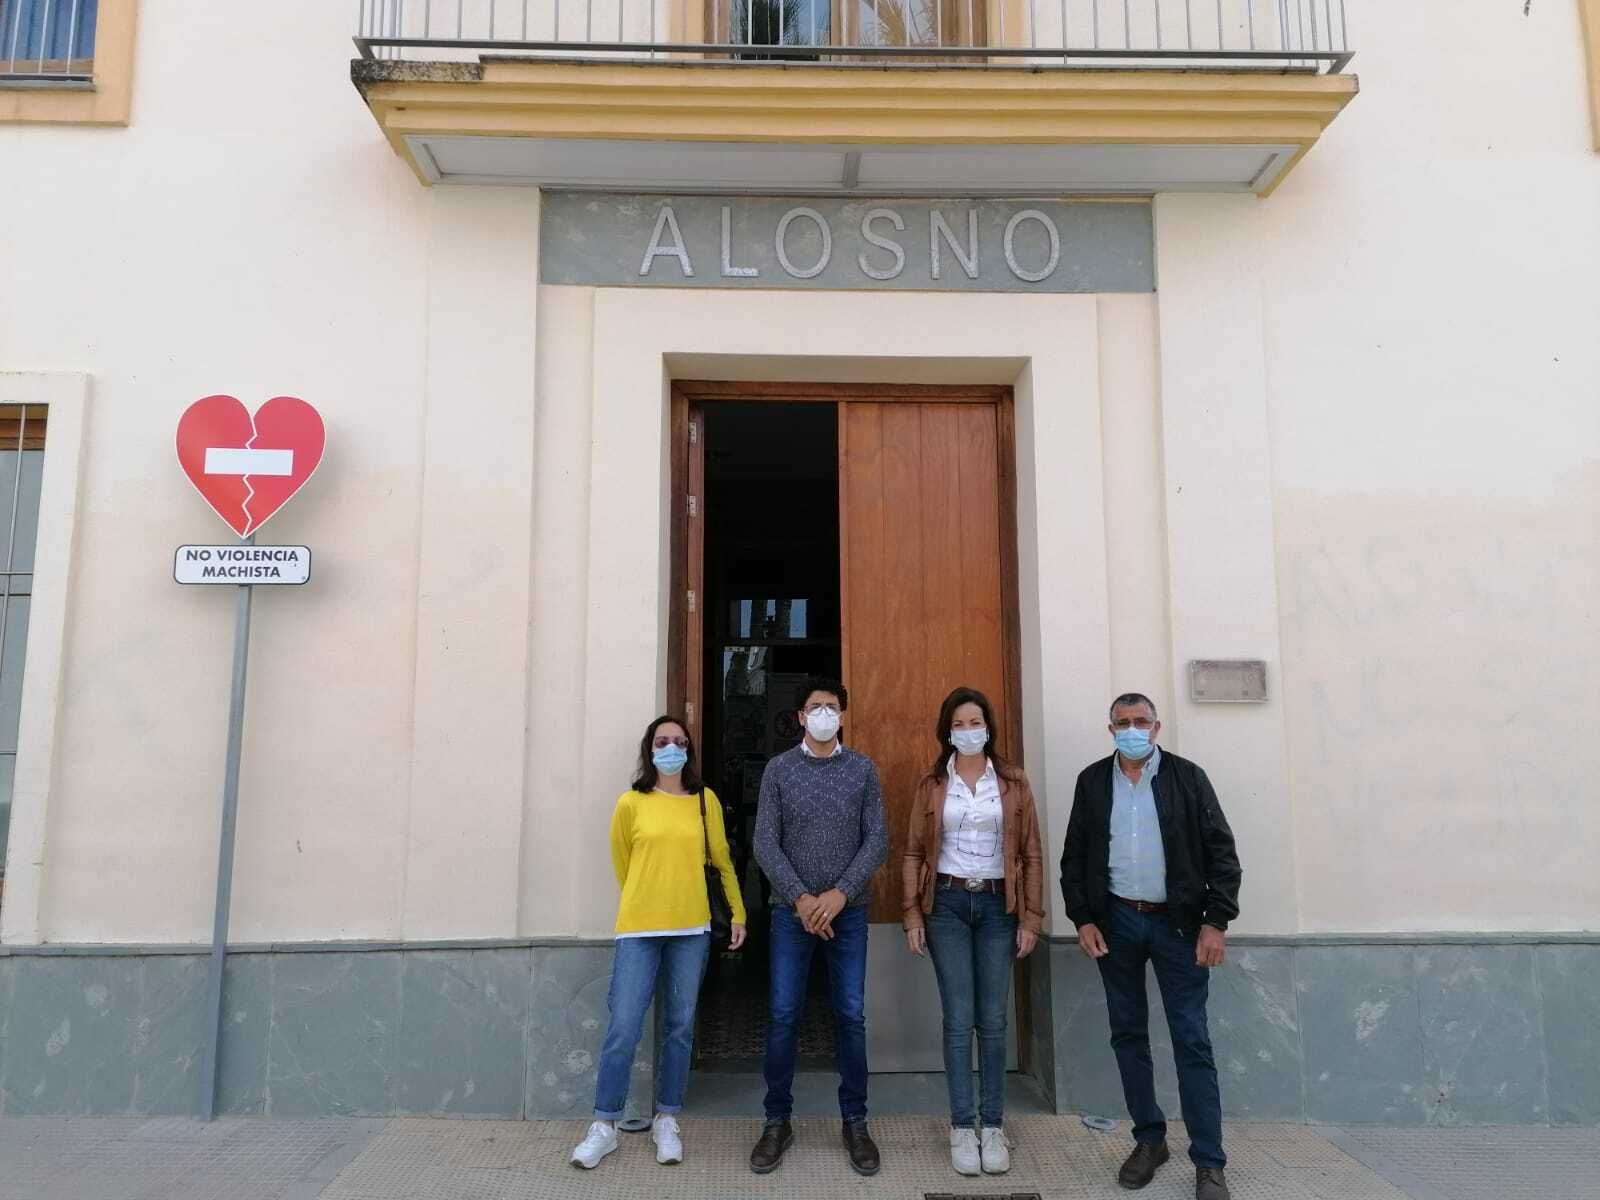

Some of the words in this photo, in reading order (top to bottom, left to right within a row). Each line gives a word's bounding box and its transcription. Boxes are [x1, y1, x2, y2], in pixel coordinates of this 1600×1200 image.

[638, 206, 1061, 282] ALOSNO
[186, 550, 211, 561] NO
[217, 550, 298, 562] VIOLENCIA
[202, 566, 281, 578] MACHISTA
